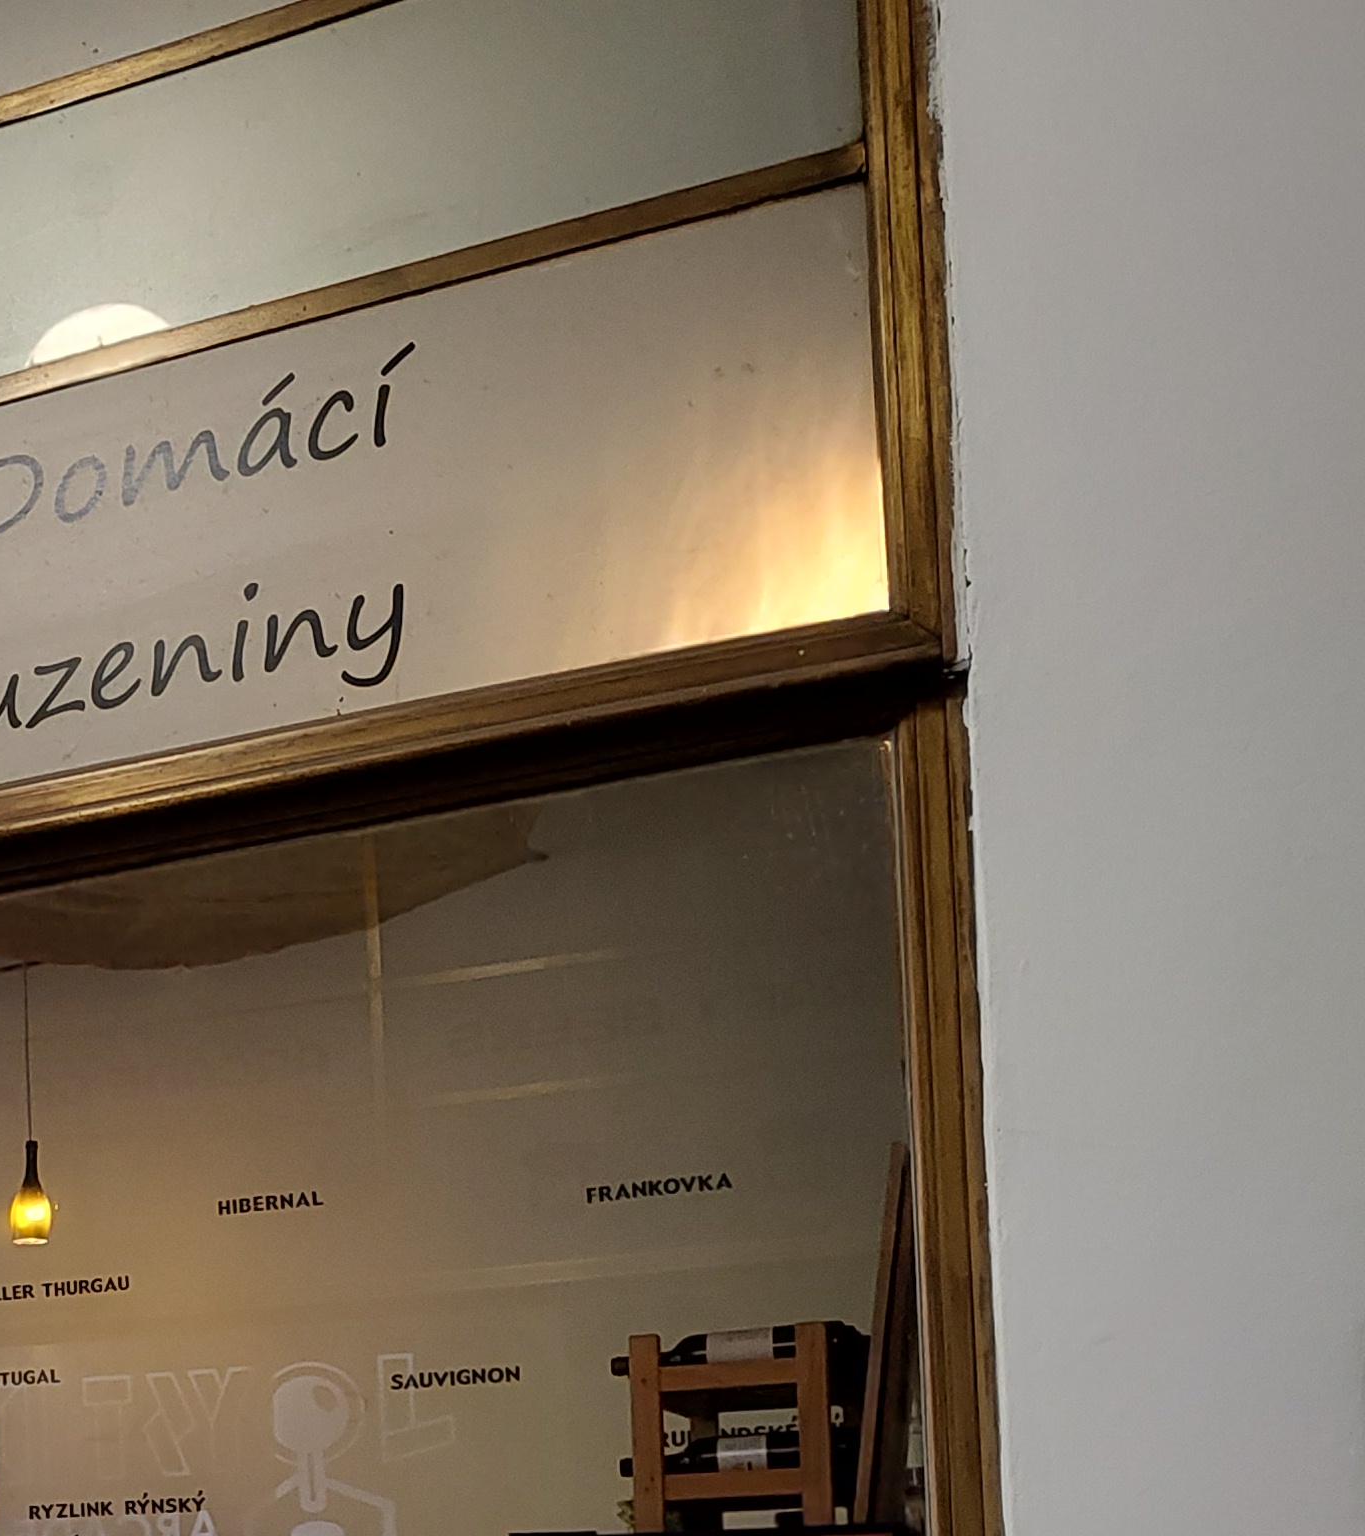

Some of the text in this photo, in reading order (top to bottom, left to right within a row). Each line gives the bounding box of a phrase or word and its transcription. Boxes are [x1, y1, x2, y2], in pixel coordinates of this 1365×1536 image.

[586, 1172, 733, 1204] FRANKOVKA
[218, 1190, 324, 1216] HIBERNAL
[41, 1275, 130, 1298] THURGAU
[390, 1365, 521, 1390] SAUVIGNON
[28, 1489, 206, 1520] RYZLINK RÝNSKÝ
